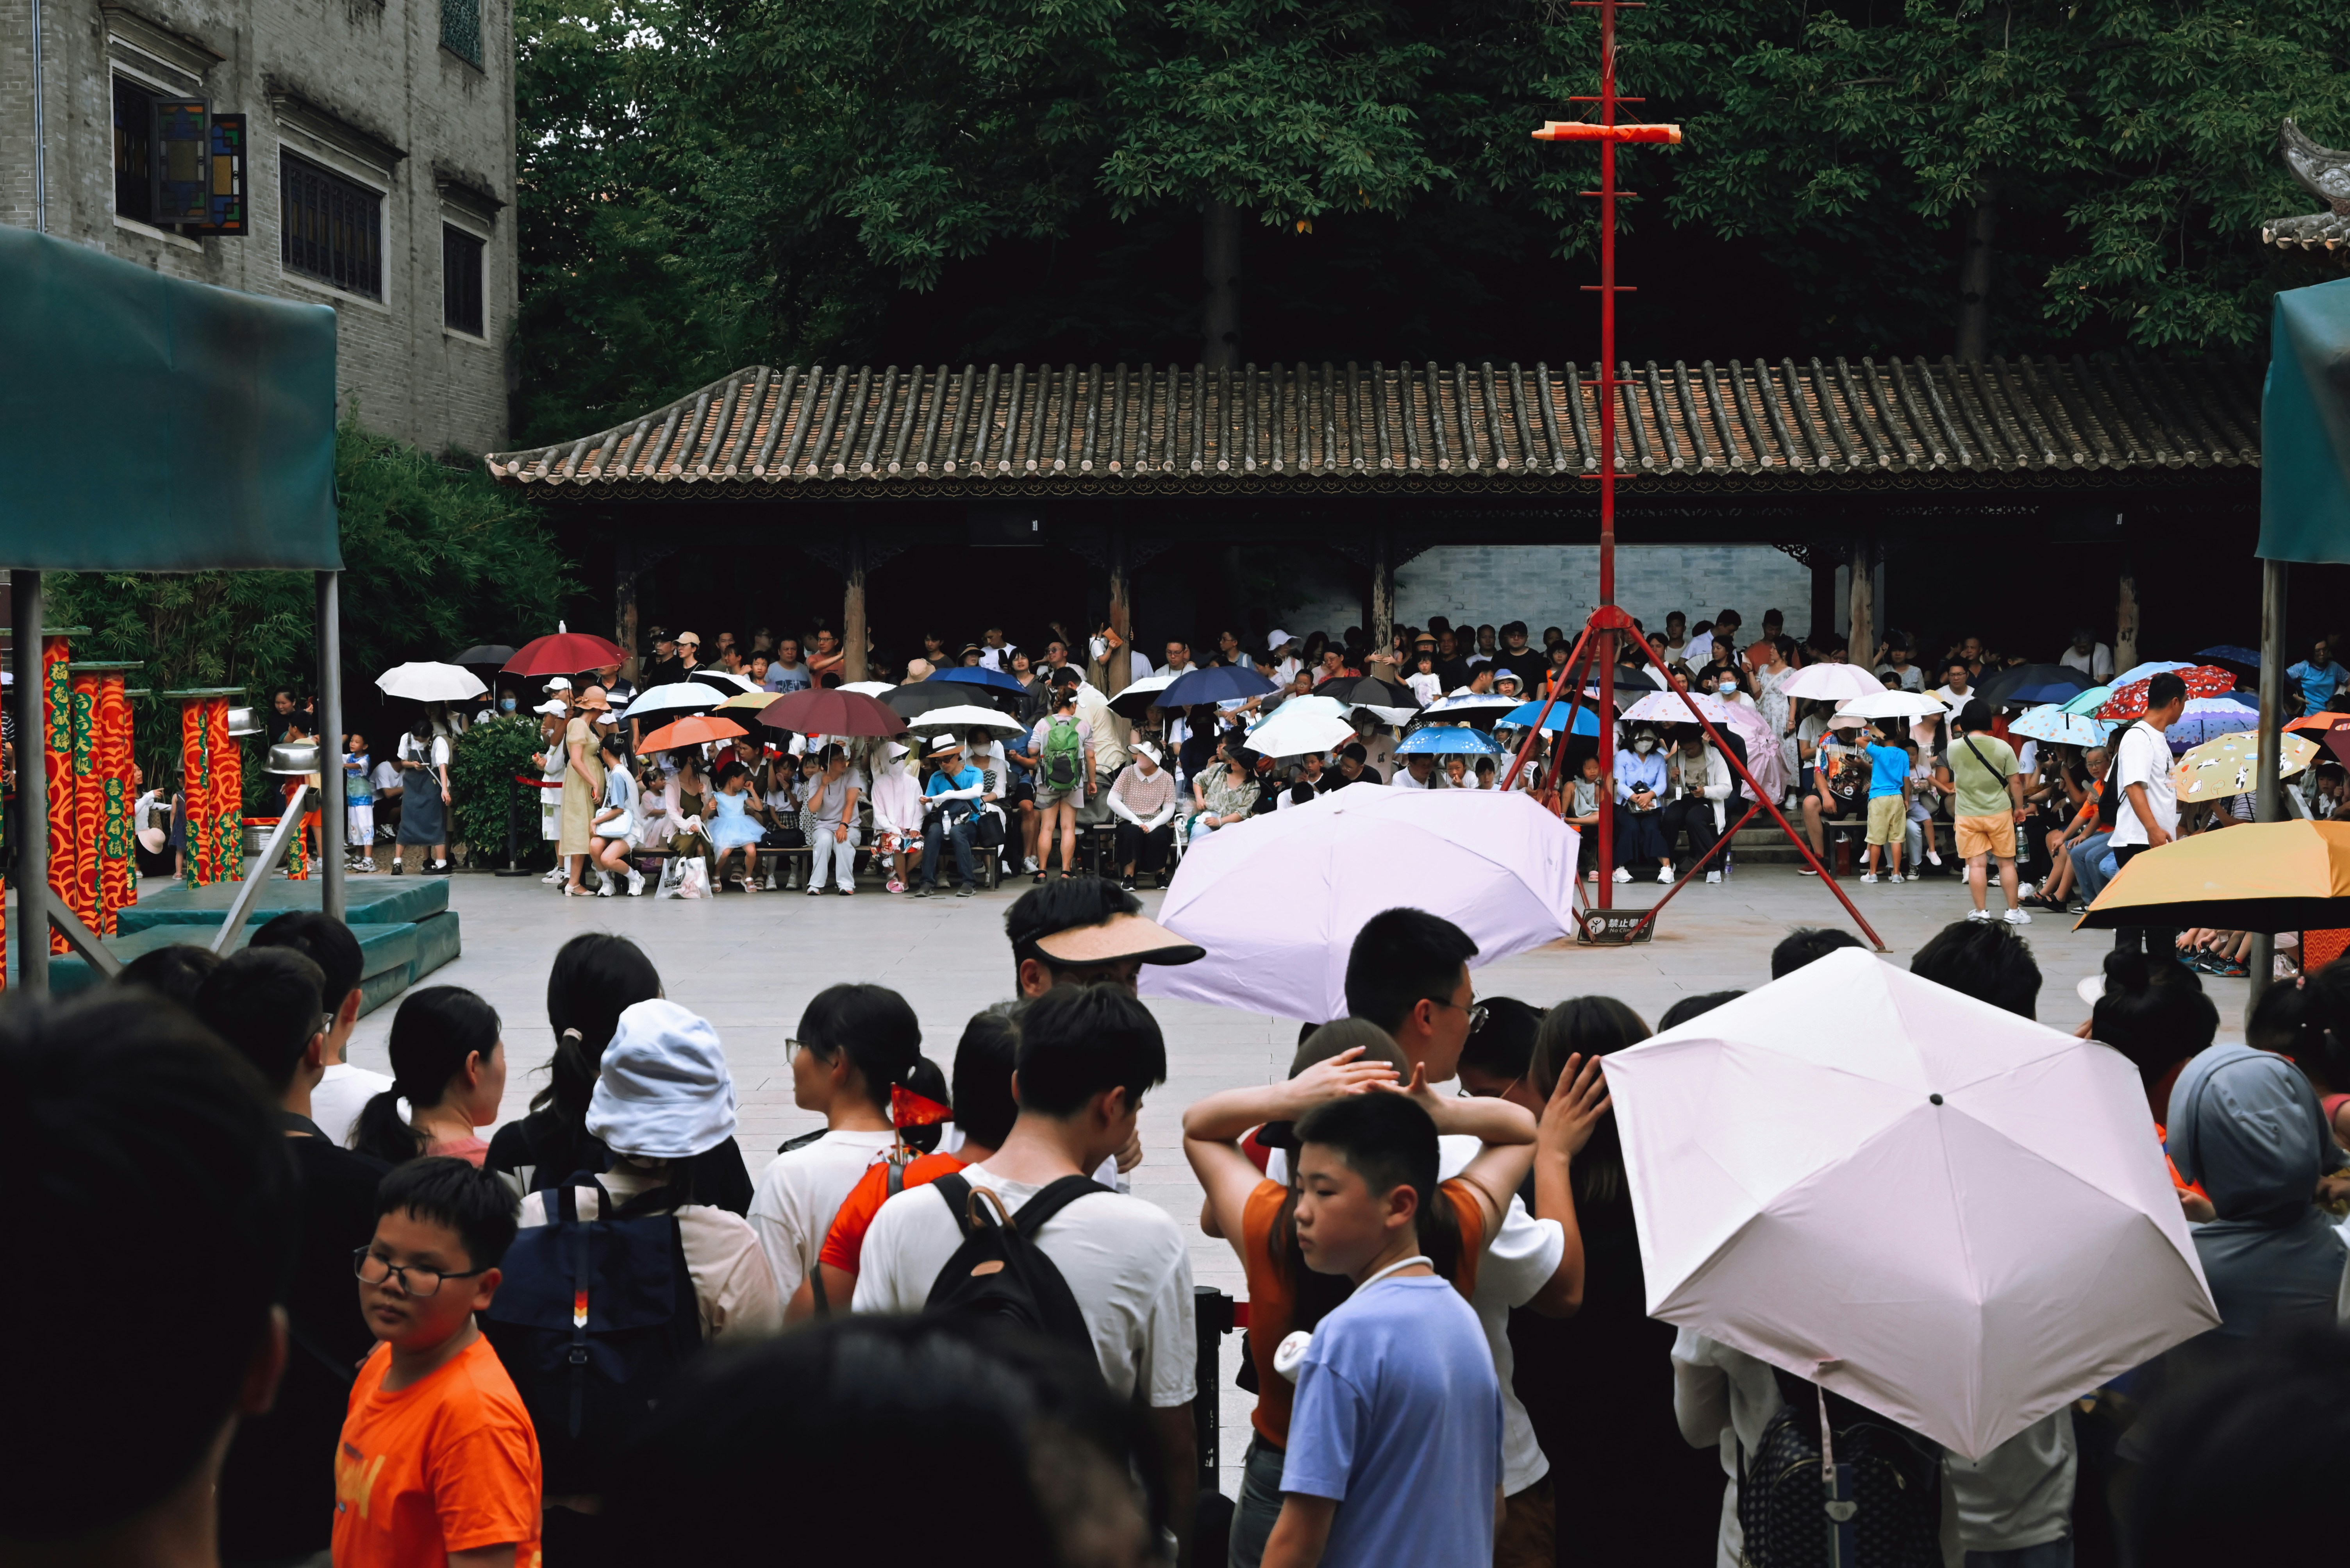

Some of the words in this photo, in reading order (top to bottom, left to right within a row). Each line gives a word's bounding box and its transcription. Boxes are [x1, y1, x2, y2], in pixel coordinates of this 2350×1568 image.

[75, 694, 92, 774] 六六大顺
[107, 779, 123, 855] 喜上眉梢
